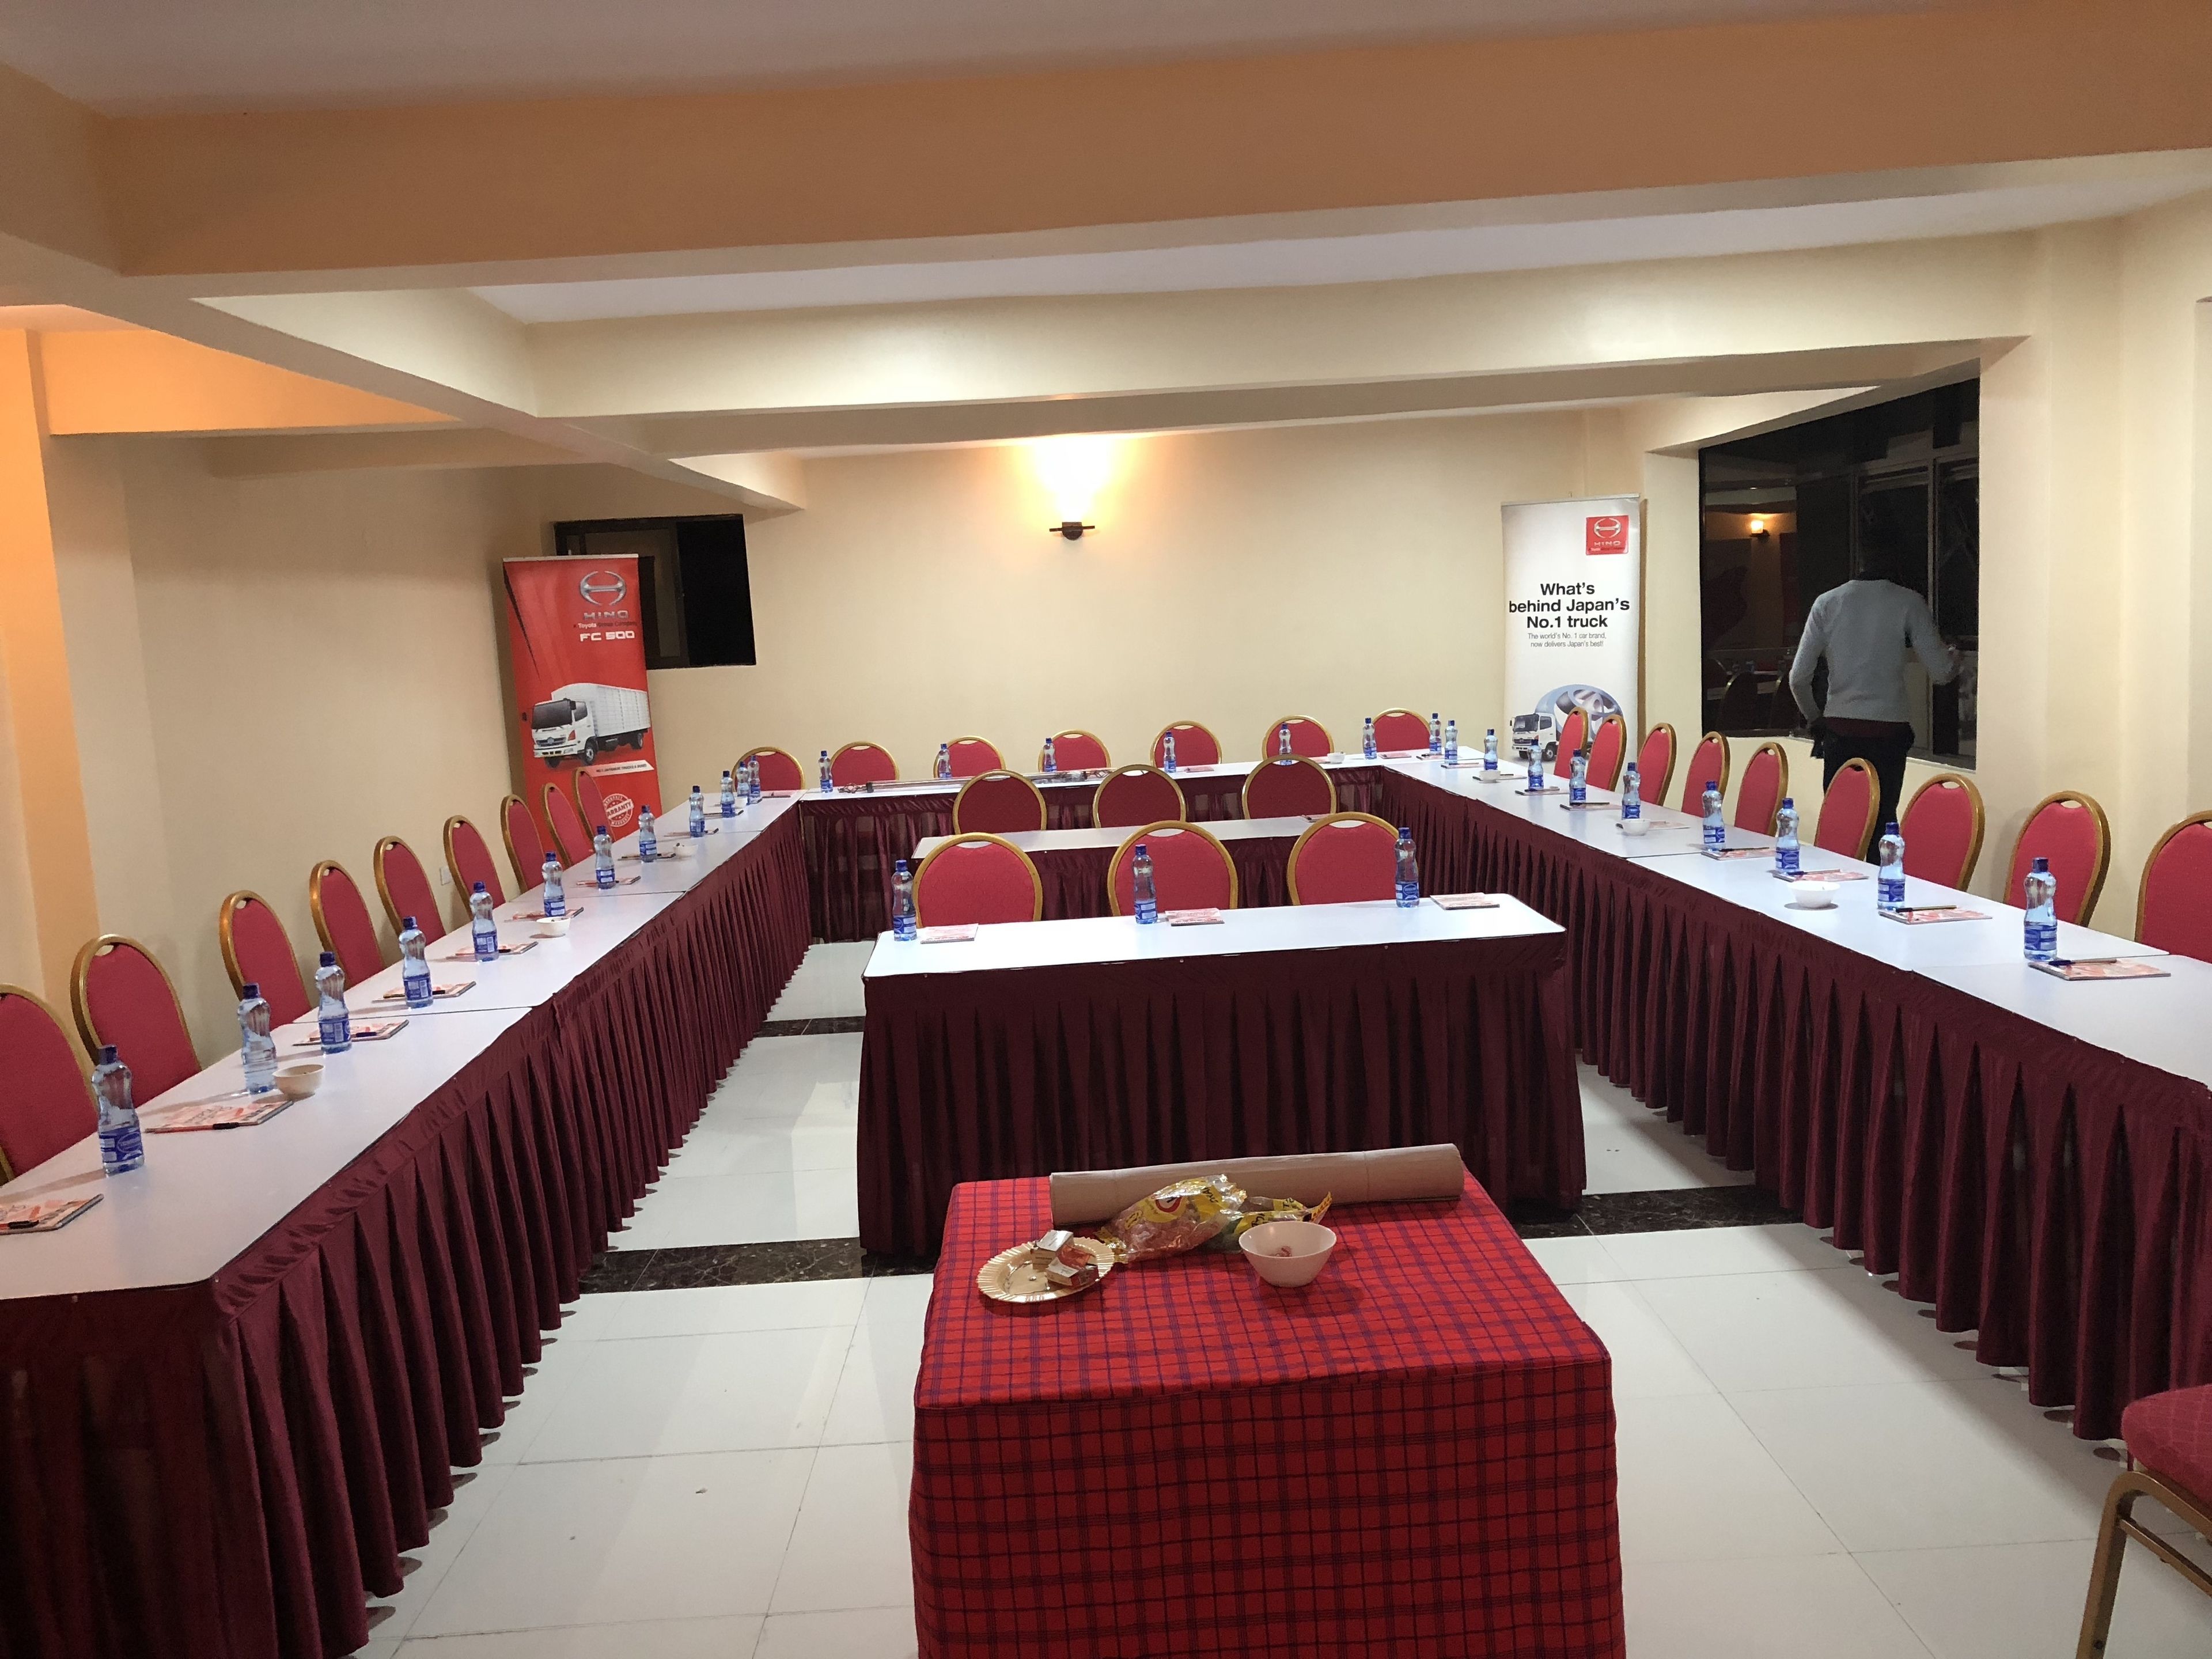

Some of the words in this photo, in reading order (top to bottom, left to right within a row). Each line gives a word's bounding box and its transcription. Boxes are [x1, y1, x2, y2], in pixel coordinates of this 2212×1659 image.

[1540, 582, 1595, 596] What's
[1509, 599, 1561, 612] behind
[1566, 598, 1630, 614] Japan's
[584, 610, 629, 620] HINO
[1527, 616, 1561, 628] No.1
[1567, 615, 1608, 627] truck
[579, 632, 602, 642] FC
[605, 630, 635, 640] 500
[607, 801, 631, 817] ARRANTY
